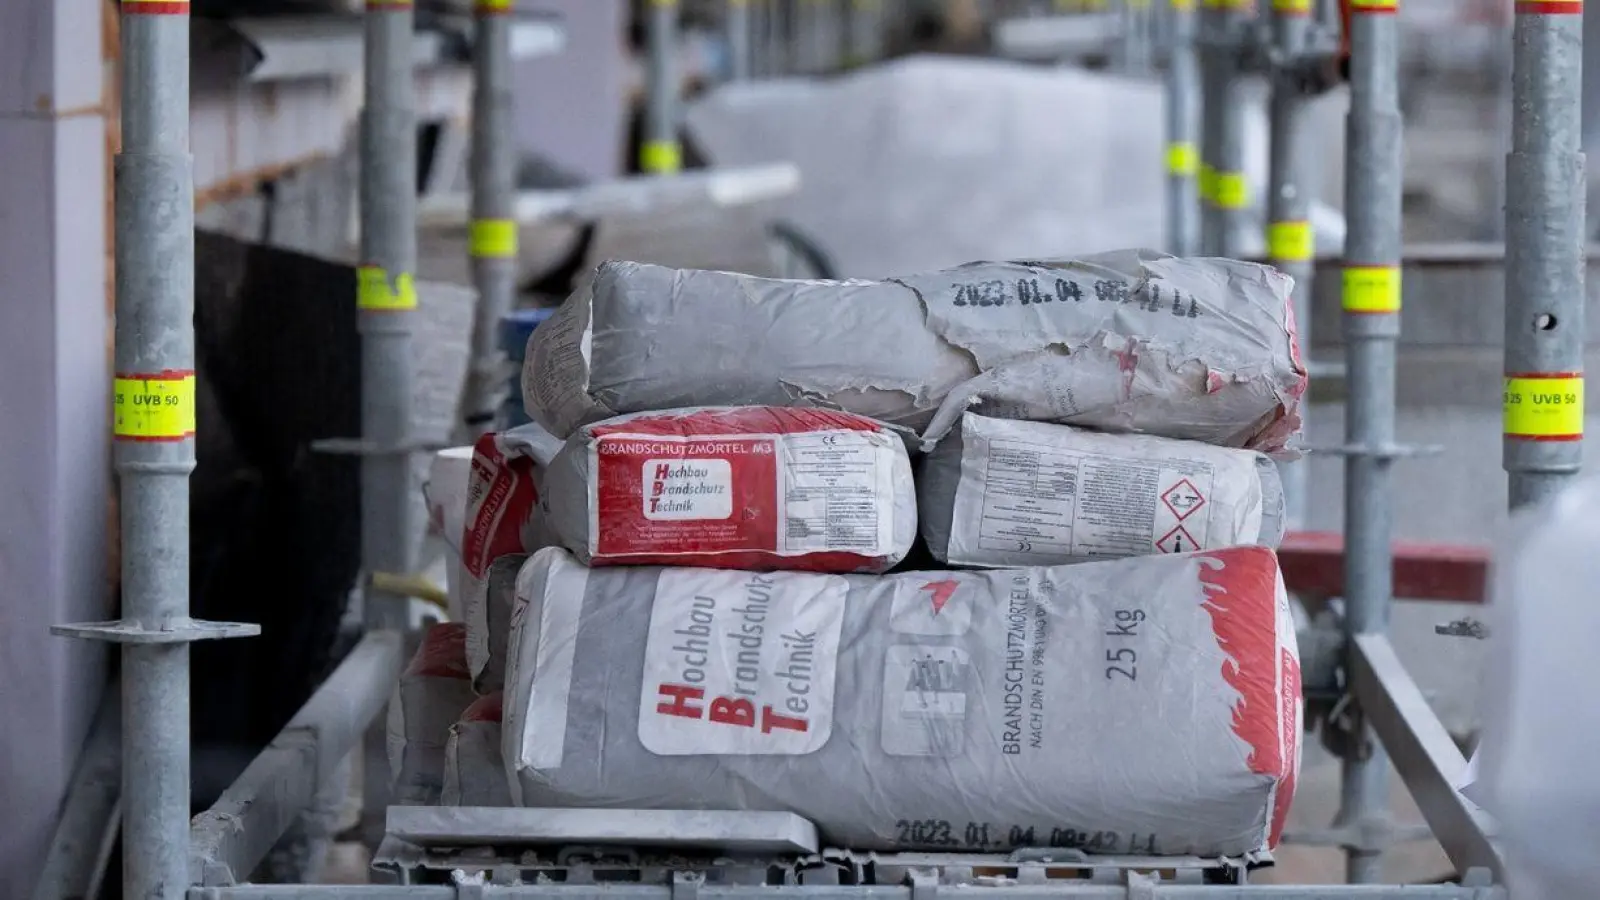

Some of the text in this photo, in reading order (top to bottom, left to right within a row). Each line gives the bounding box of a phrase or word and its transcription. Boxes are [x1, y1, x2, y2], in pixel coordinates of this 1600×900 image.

[133, 394, 161, 406] UVB
[165, 395, 179, 406] 50
[1532, 393, 1562, 405] UVB
[1564, 393, 1577, 404] 50
[601, 442, 773, 456] BRANDSCHUTZMÖRTEL M3
[654, 463, 709, 480] Hochbau
[651, 481, 725, 497] Brandschutz
[649, 498, 694, 513] Technik
[708, 574, 774, 728] Brandschutz
[1105, 608, 1146, 681] 25 kg
[656, 595, 716, 719] Hochbau
[1002, 587, 1030, 755] BRANDSCHUTZMÖRTEL
[1031, 669, 1044, 687] EN
[761, 629, 817, 734] Technik
[1030, 688, 1044, 710] DIN
[1029, 712, 1042, 749] NACH
